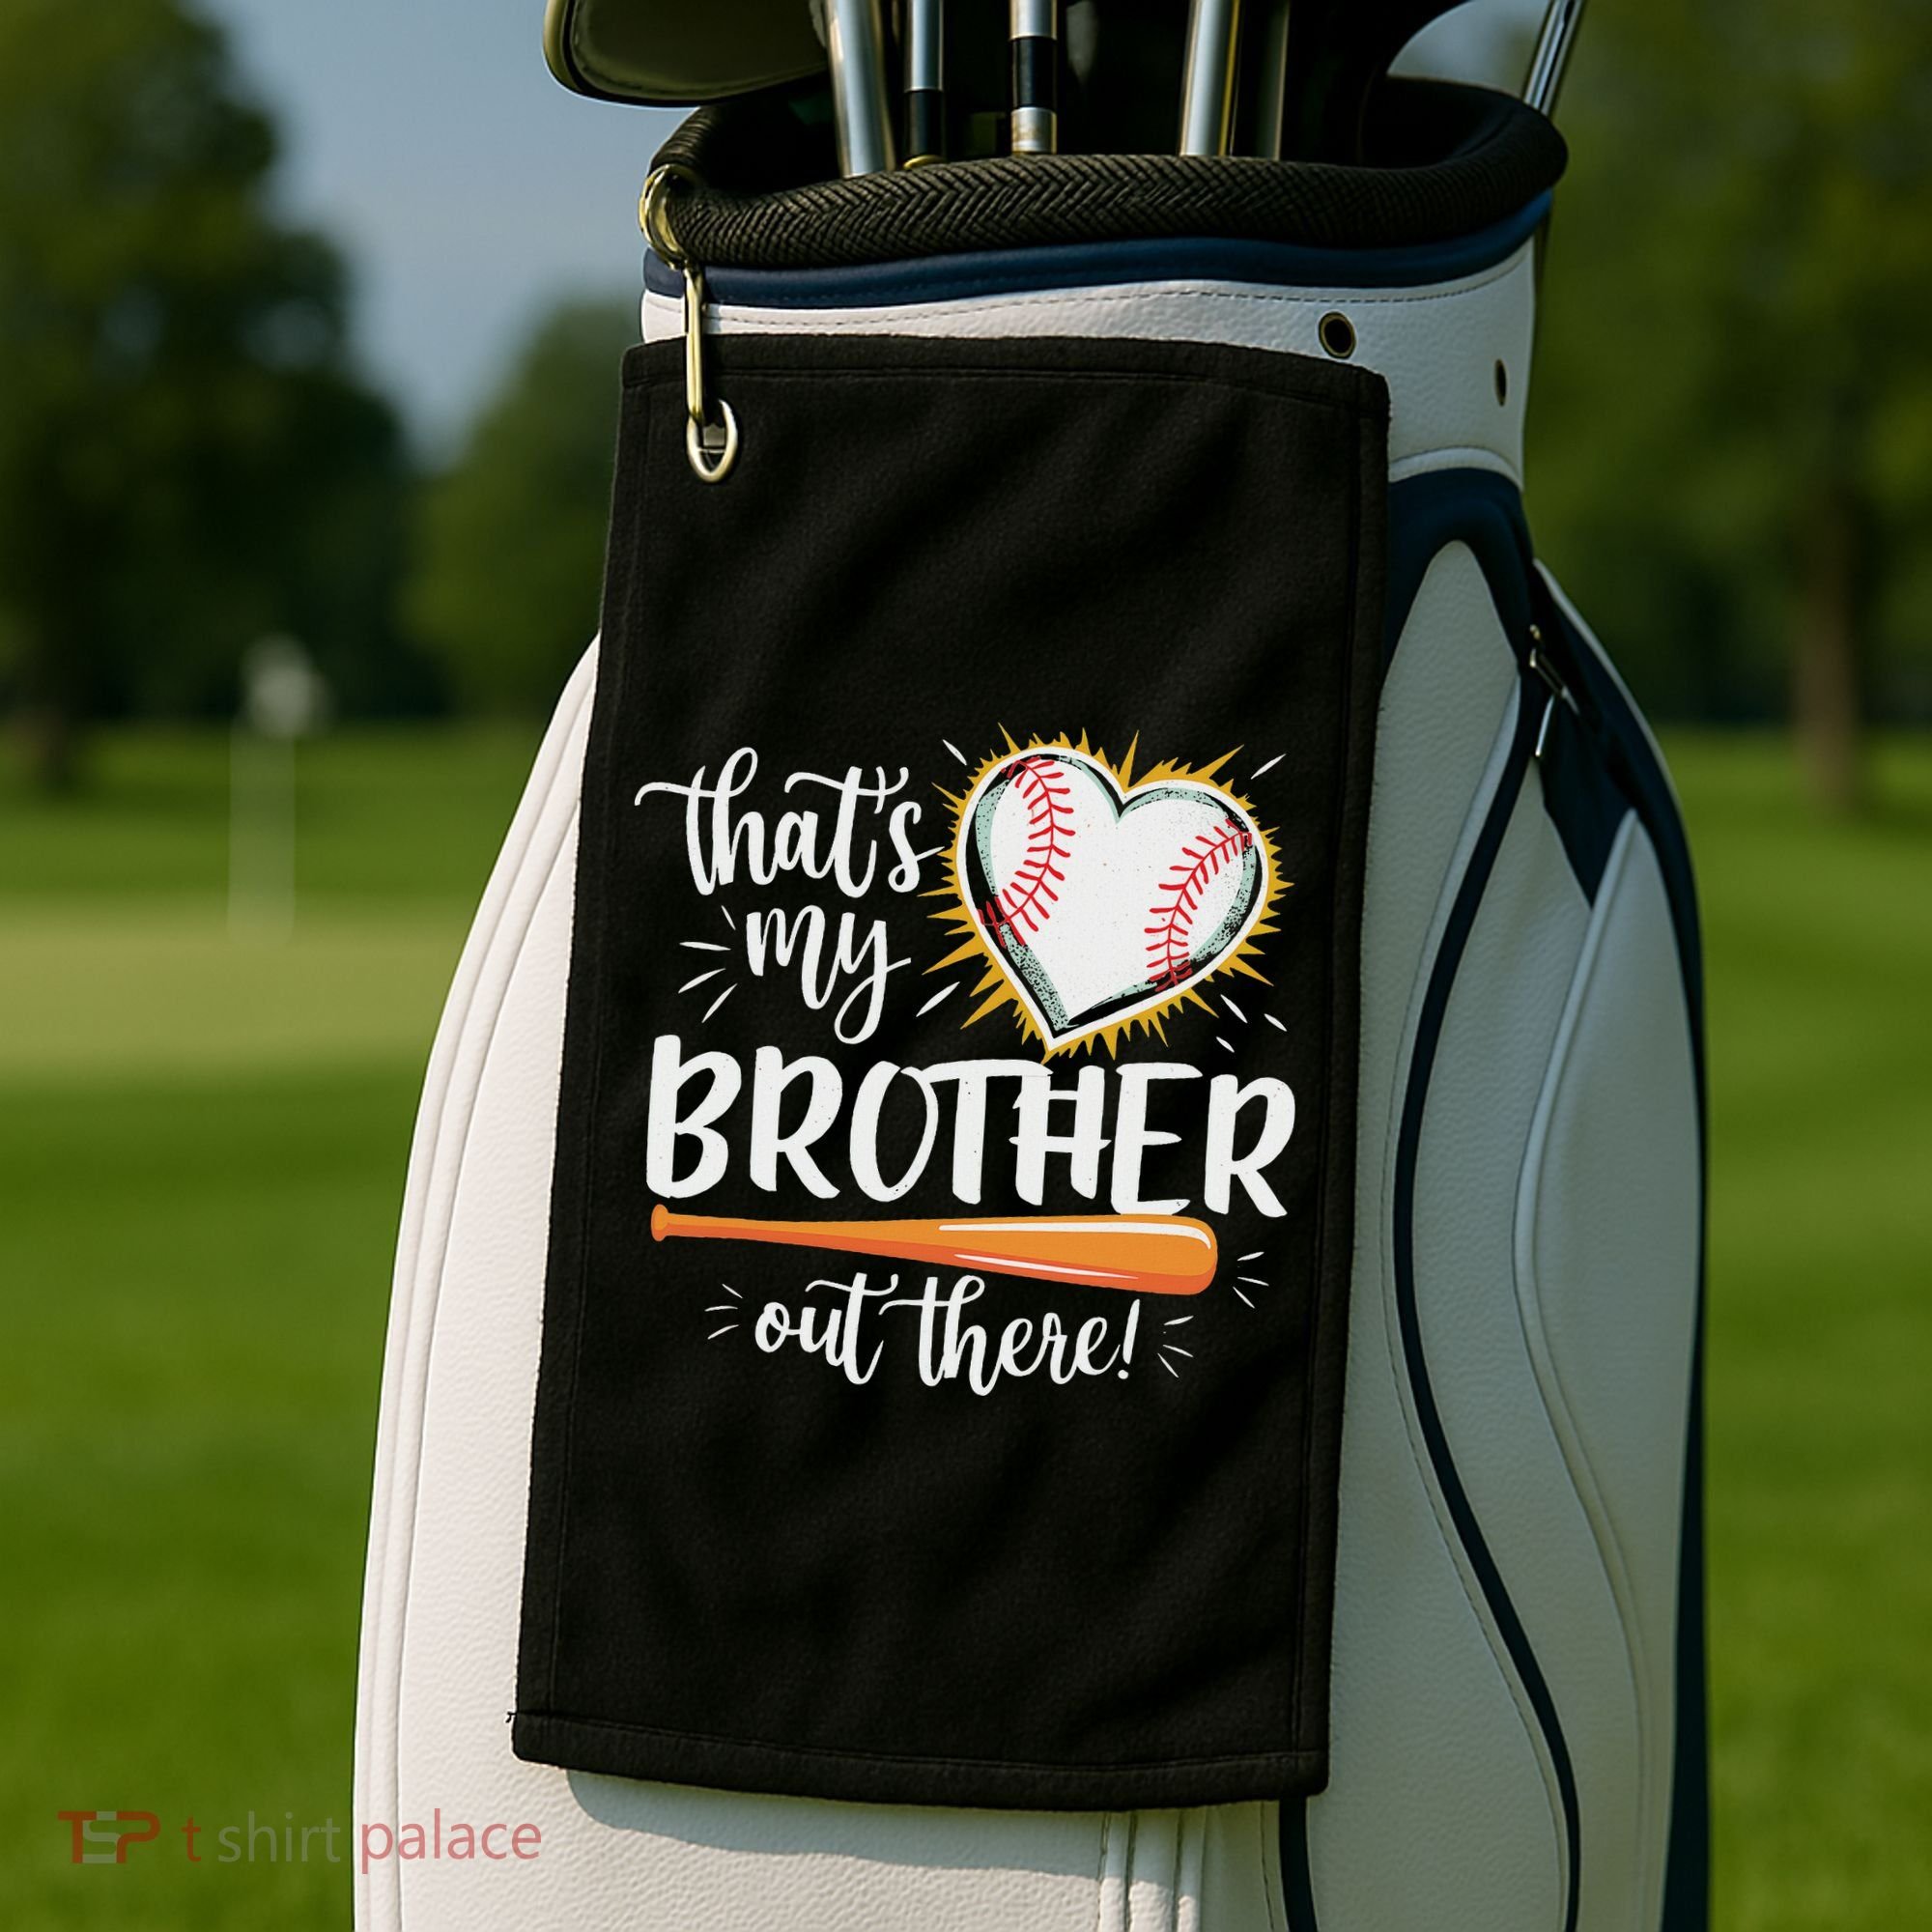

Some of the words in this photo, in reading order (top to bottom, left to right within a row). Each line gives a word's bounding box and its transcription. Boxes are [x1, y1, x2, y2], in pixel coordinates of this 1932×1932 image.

[635, 747, 944, 897] that's
[746, 904, 911, 1044] my
[645, 1035, 1295, 1217] BROTHER
[755, 1272, 898, 1386] out
[879, 1274, 1141, 1396] there!
